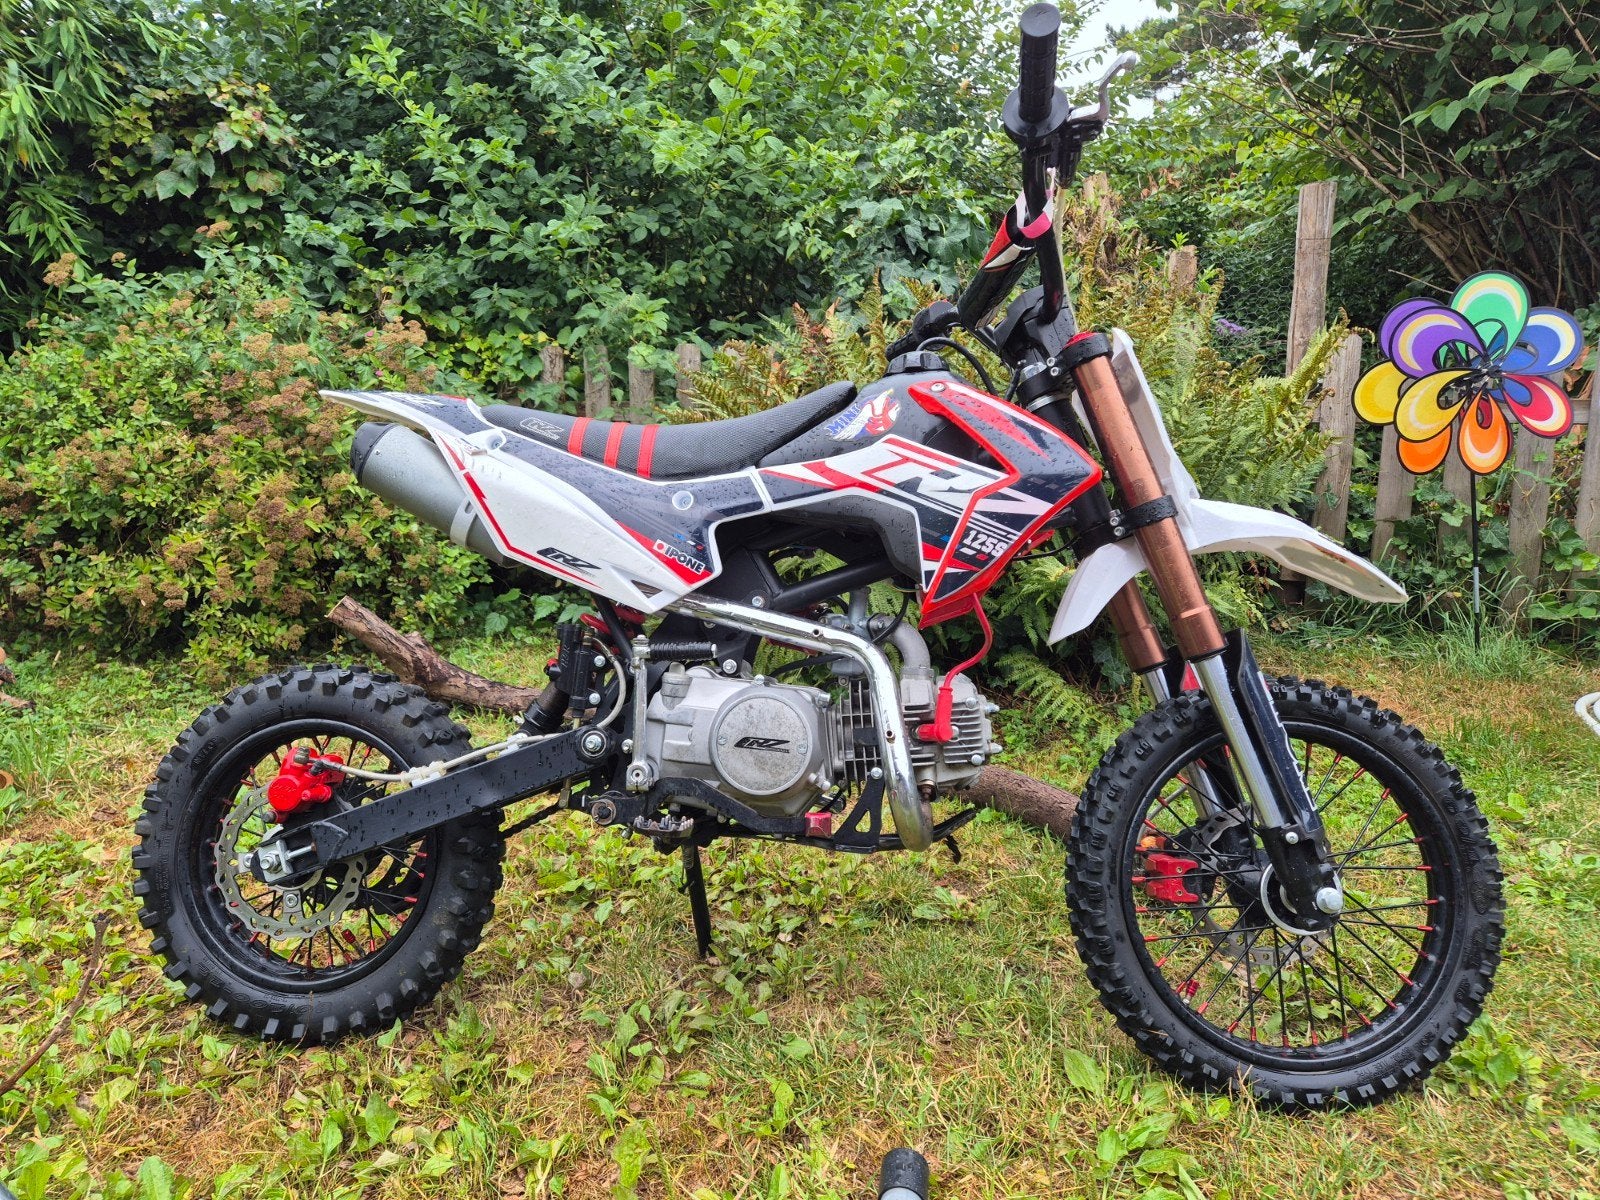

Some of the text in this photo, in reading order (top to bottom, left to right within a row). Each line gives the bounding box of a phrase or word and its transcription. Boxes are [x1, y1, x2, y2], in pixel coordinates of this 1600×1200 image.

[825, 403, 861, 434] MINI
[963, 531, 1008, 557] 125S
[664, 547, 704, 573] IPONE
